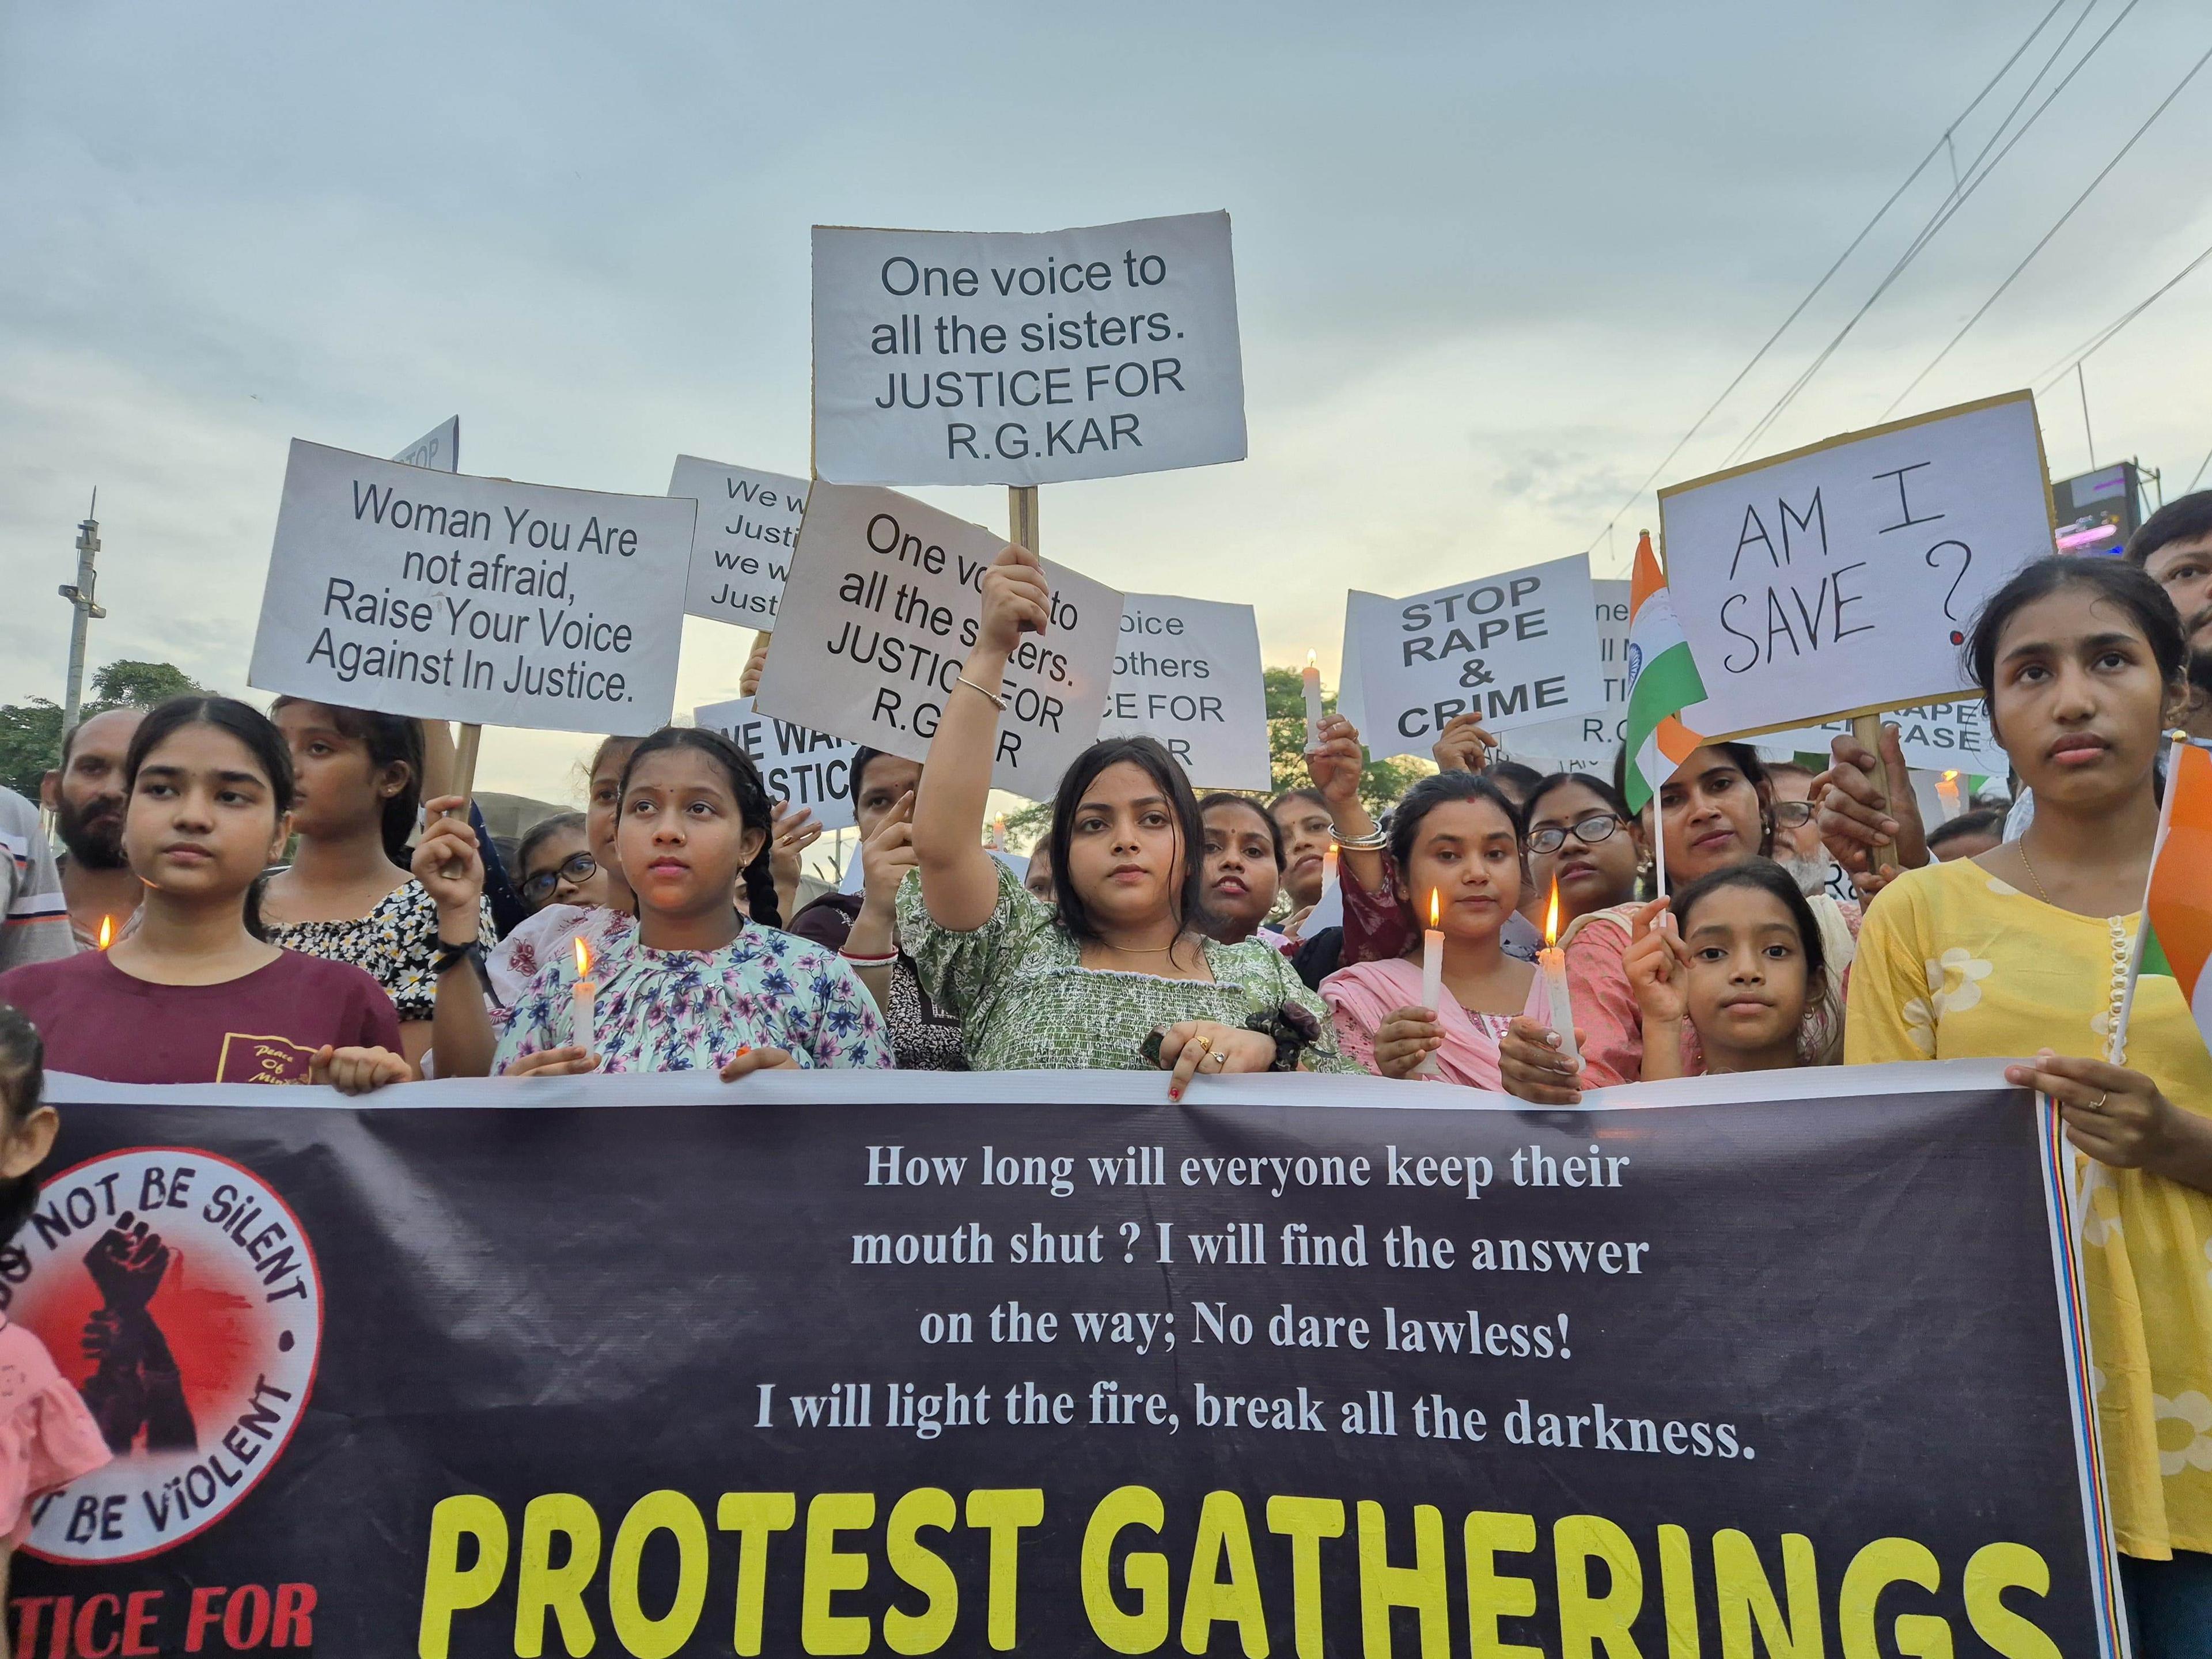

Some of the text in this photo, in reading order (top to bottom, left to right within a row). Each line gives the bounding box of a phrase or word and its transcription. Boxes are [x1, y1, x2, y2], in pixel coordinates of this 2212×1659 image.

[881, 249, 1166, 296] One voice to
[871, 310, 1184, 354] all the sisters.
[875, 358, 1185, 408] JUSTICE FOR
[399, 438, 438, 470] TOP
[948, 414, 1143, 459] R.G.KAR
[353, 480, 638, 557] Woman You Are
[727, 478, 777, 507] We
[1730, 461, 1945, 579] AM I
[403, 551, 575, 605] not afraid,
[715, 551, 759, 574] we
[867, 513, 945, 575] One
[1051, 590, 1078, 630] to
[324, 578, 632, 653] Raise Your Voice
[839, 571, 888, 612] all
[894, 584, 953, 636] the
[1120, 610, 1184, 635] oice
[1402, 577, 1541, 632] STOP
[1721, 540, 1972, 673] SAVE ?
[827, 621, 964, 694] JUSTIC
[1403, 608, 1548, 666] RAPE
[306, 628, 633, 703] Against In Justice.
[1113, 652, 1210, 679] others
[1459, 658, 1495, 688] &
[1149, 694, 1225, 722] FOR
[1397, 675, 1569, 738] CRIME
[1885, 703, 1979, 726] APE
[865, 1144, 1630, 1200] How long will everyone keep their
[31, 1173, 119, 1250] NOT
[139, 1167, 195, 1210] BE
[851, 1222, 1650, 1275] mouth shut ? I will find the answer
[921, 1301, 1571, 1359] on the way; No dare lawless!
[753, 1381, 1756, 1460] I will light the fire, break all the darkness.
[65, 1495, 127, 1544] BE
[418, 1484, 2052, 1659] PROTEST GATHERINGS
[185, 1582, 317, 1652] FOR
